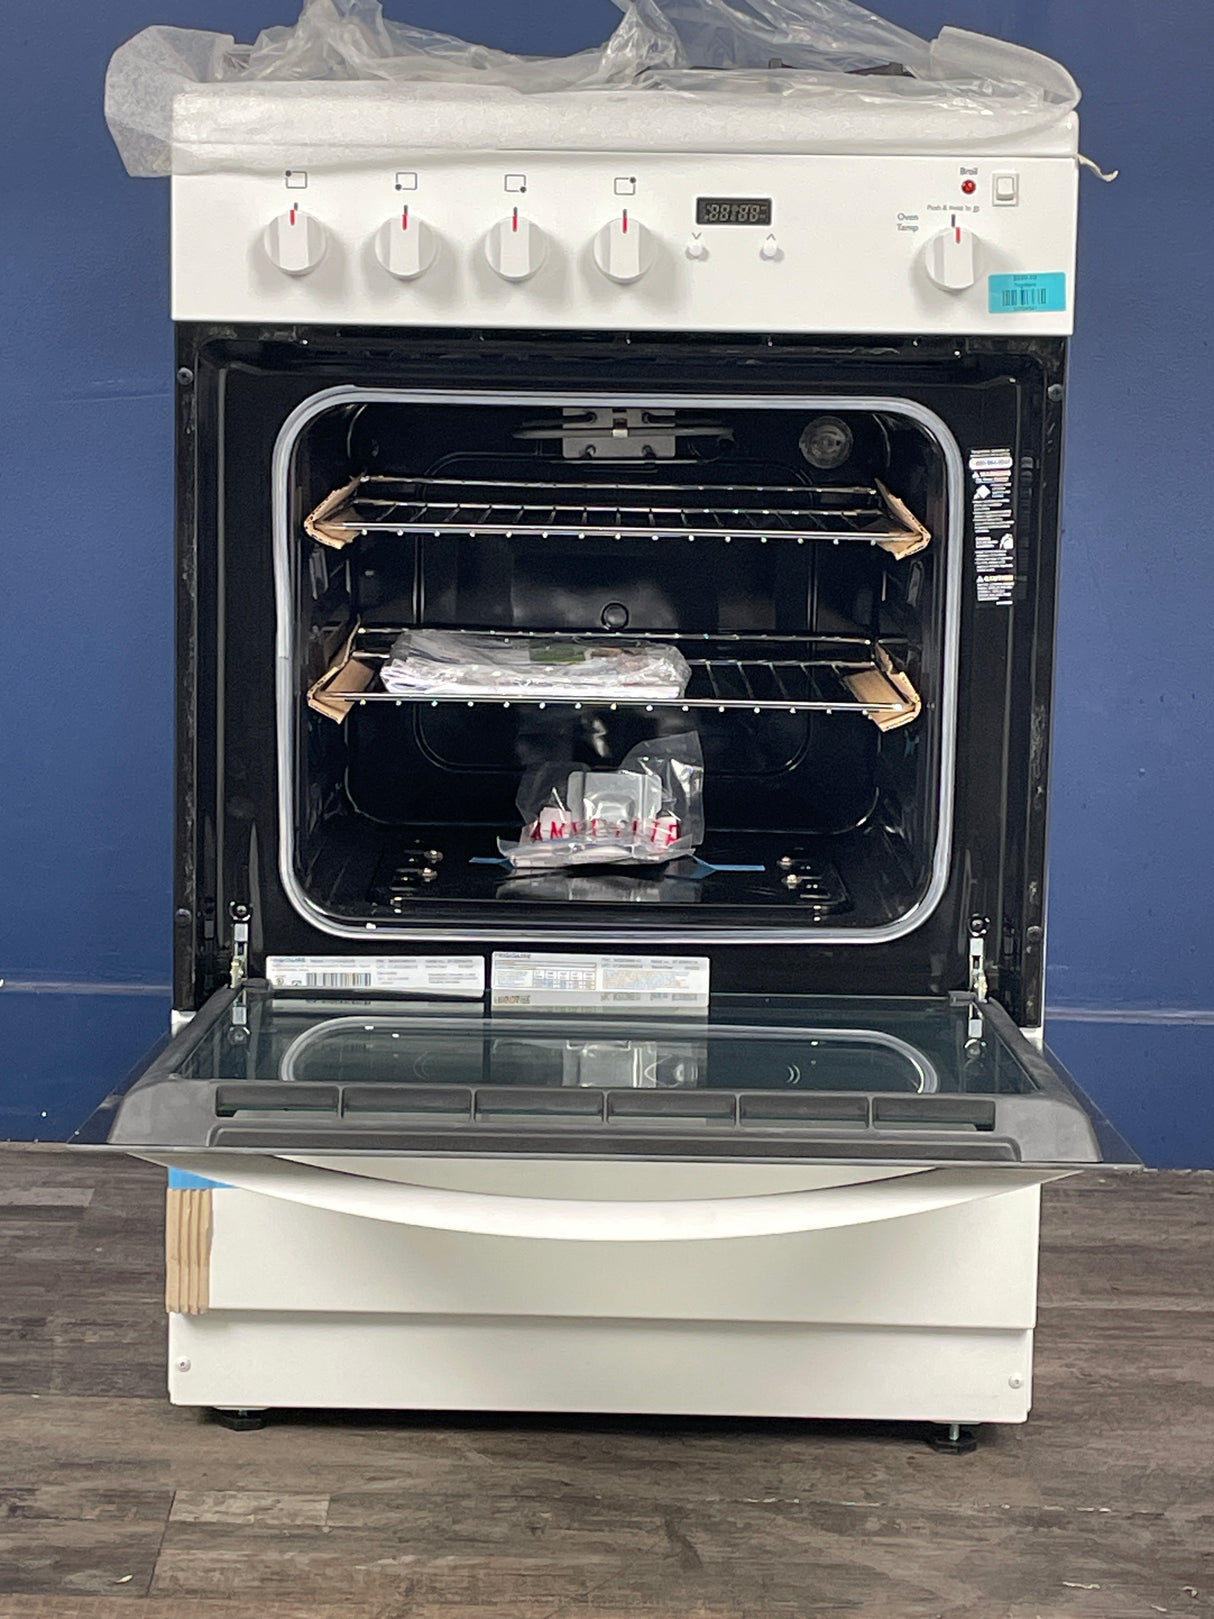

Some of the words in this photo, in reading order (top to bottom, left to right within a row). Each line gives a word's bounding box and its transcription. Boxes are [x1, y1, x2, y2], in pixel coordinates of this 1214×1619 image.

[960, 167, 978, 175] Broil
[897, 212, 919, 221] Oven
[897, 223, 919, 232] Temp
